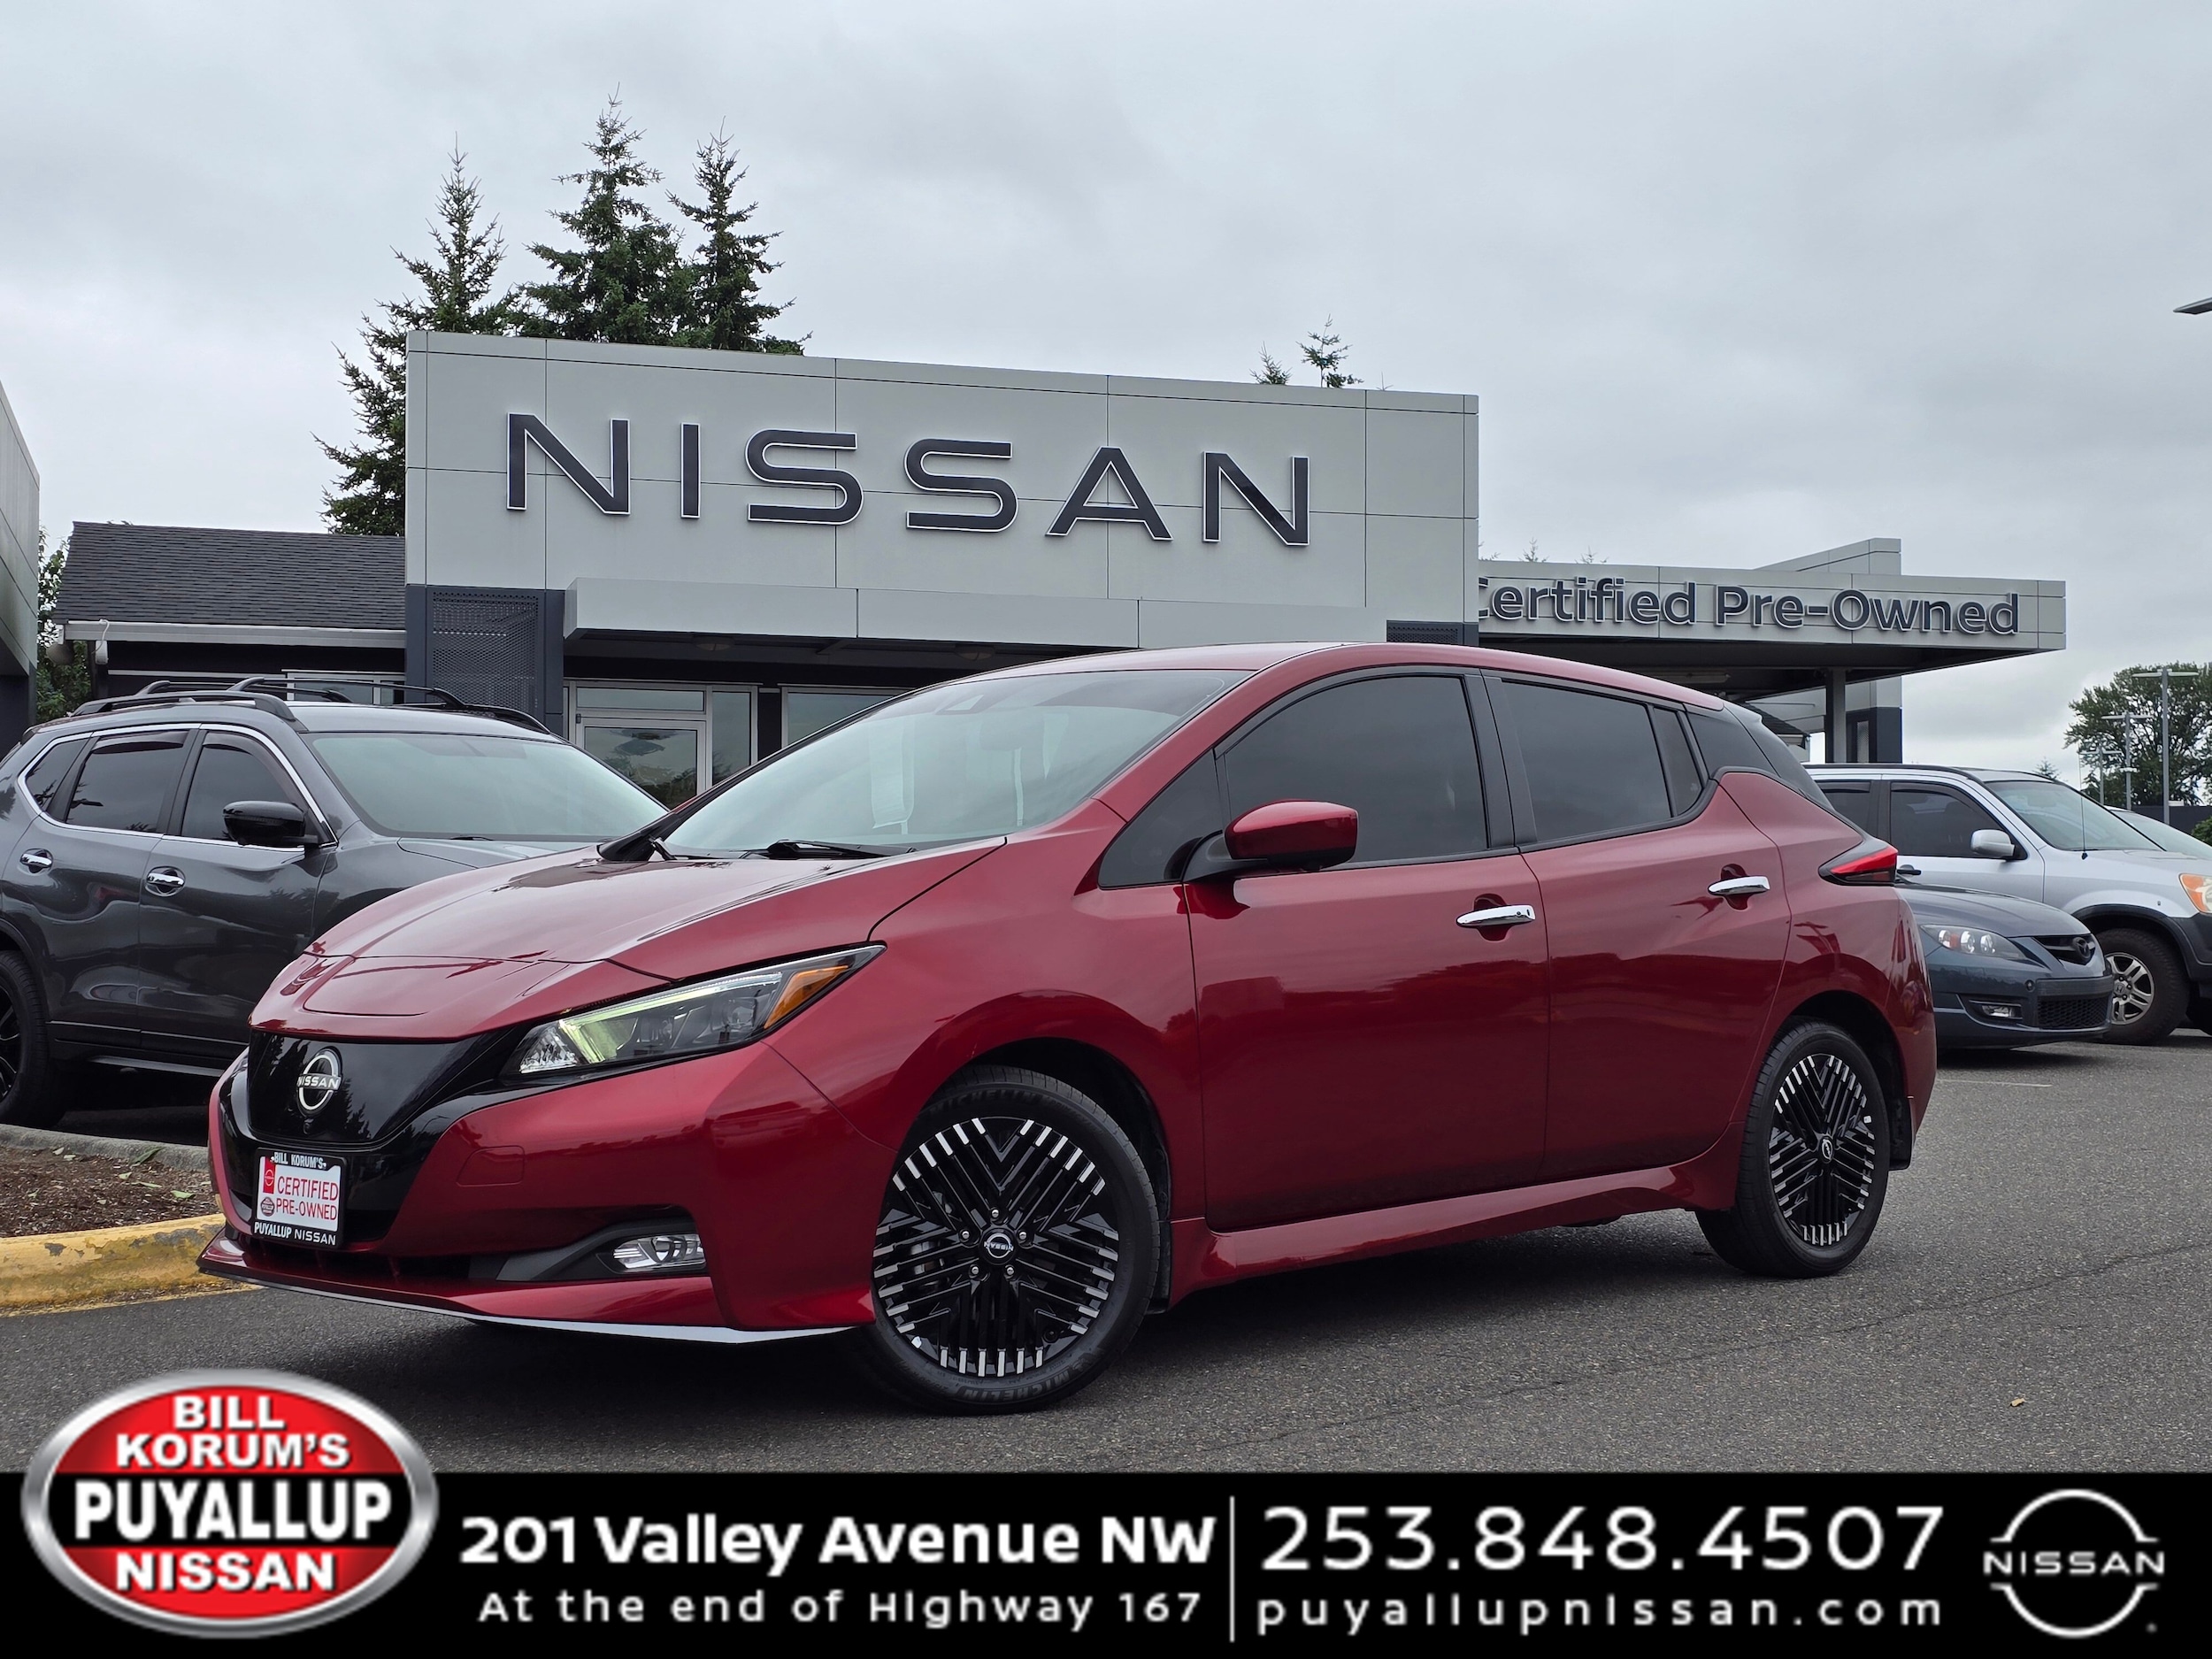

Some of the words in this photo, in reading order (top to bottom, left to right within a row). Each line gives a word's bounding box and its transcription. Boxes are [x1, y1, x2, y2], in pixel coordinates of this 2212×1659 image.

[507, 411, 1310, 547] NISSAN
[1714, 585, 2019, 635] Pre-Owned
[296, 1075, 339, 1089] NISSAN
[273, 1151, 288, 1164] BILL
[291, 1154, 324, 1169] KORUM'S
[277, 1176, 339, 1201] CERTIFIED
[276, 1198, 337, 1220] PRE-OWNED
[254, 1222, 292, 1239] PUYALLUP
[294, 1229, 336, 1246] NISSAN
[964, 1370, 1071, 1402] MICHELIN
